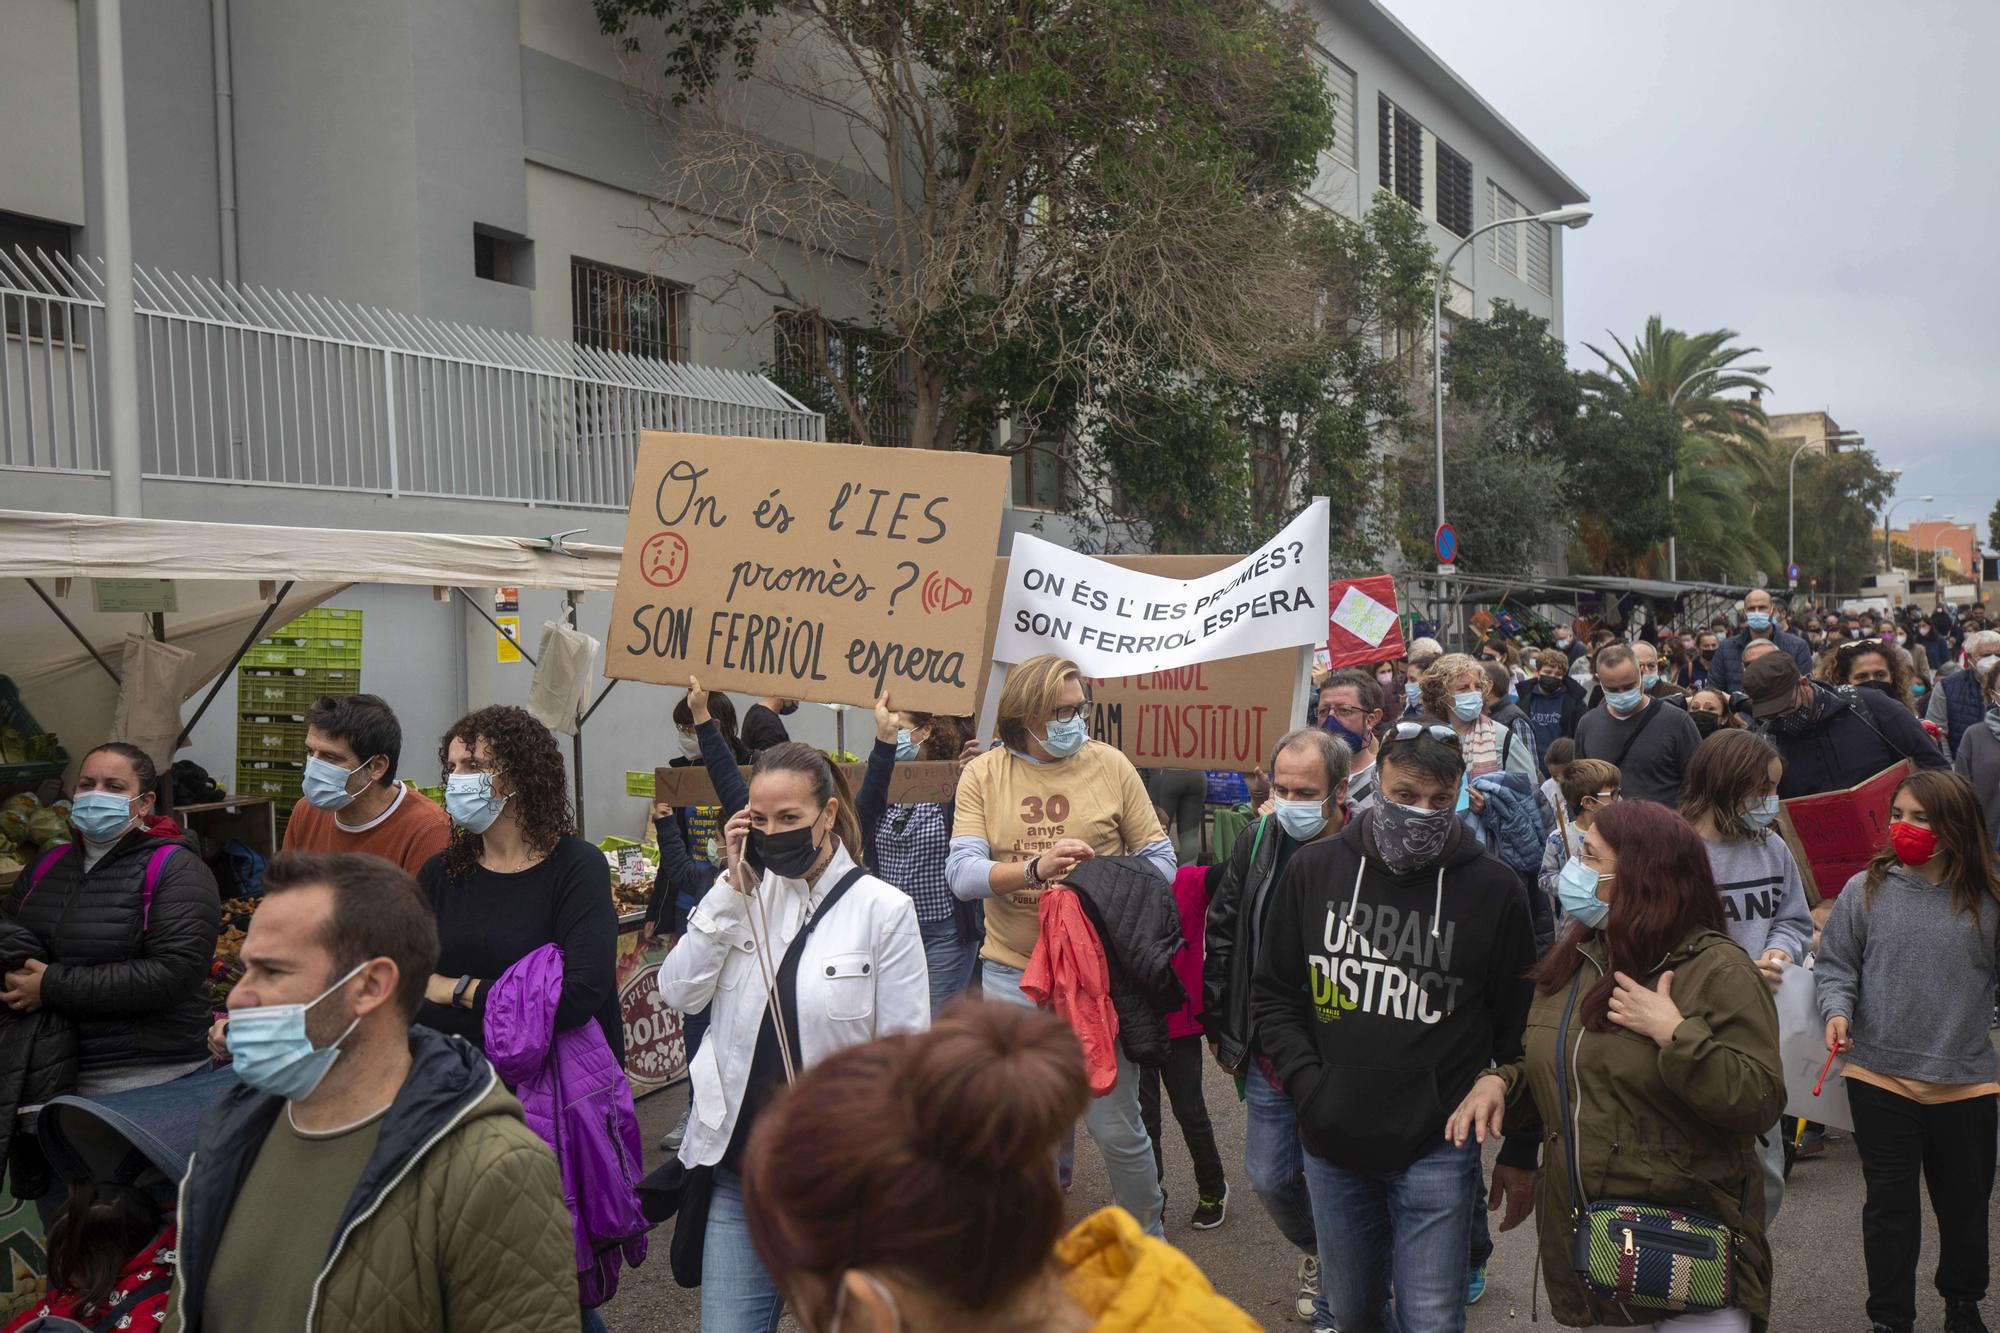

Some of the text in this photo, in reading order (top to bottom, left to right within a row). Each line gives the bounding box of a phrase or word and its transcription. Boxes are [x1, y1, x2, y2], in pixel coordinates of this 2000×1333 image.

[655, 460, 949, 544] On és l'IES
[1014, 609, 1072, 640] SON
[1078, 626, 1196, 654] FERRIOL
[1203, 586, 1315, 638] ESPERA
[1023, 568, 1065, 598] ON
[1071, 580, 1110, 612] ÉS
[1143, 603, 1187, 621] IES
[627, 604, 693, 660] SON
[845, 638, 965, 699] espera
[1020, 794, 1070, 824] 30
[1027, 824, 1065, 839] anys
[1717, 880, 1784, 921] ANS
[1324, 901, 1456, 971] URBAN
[1309, 955, 1464, 1024] DISTRICT
